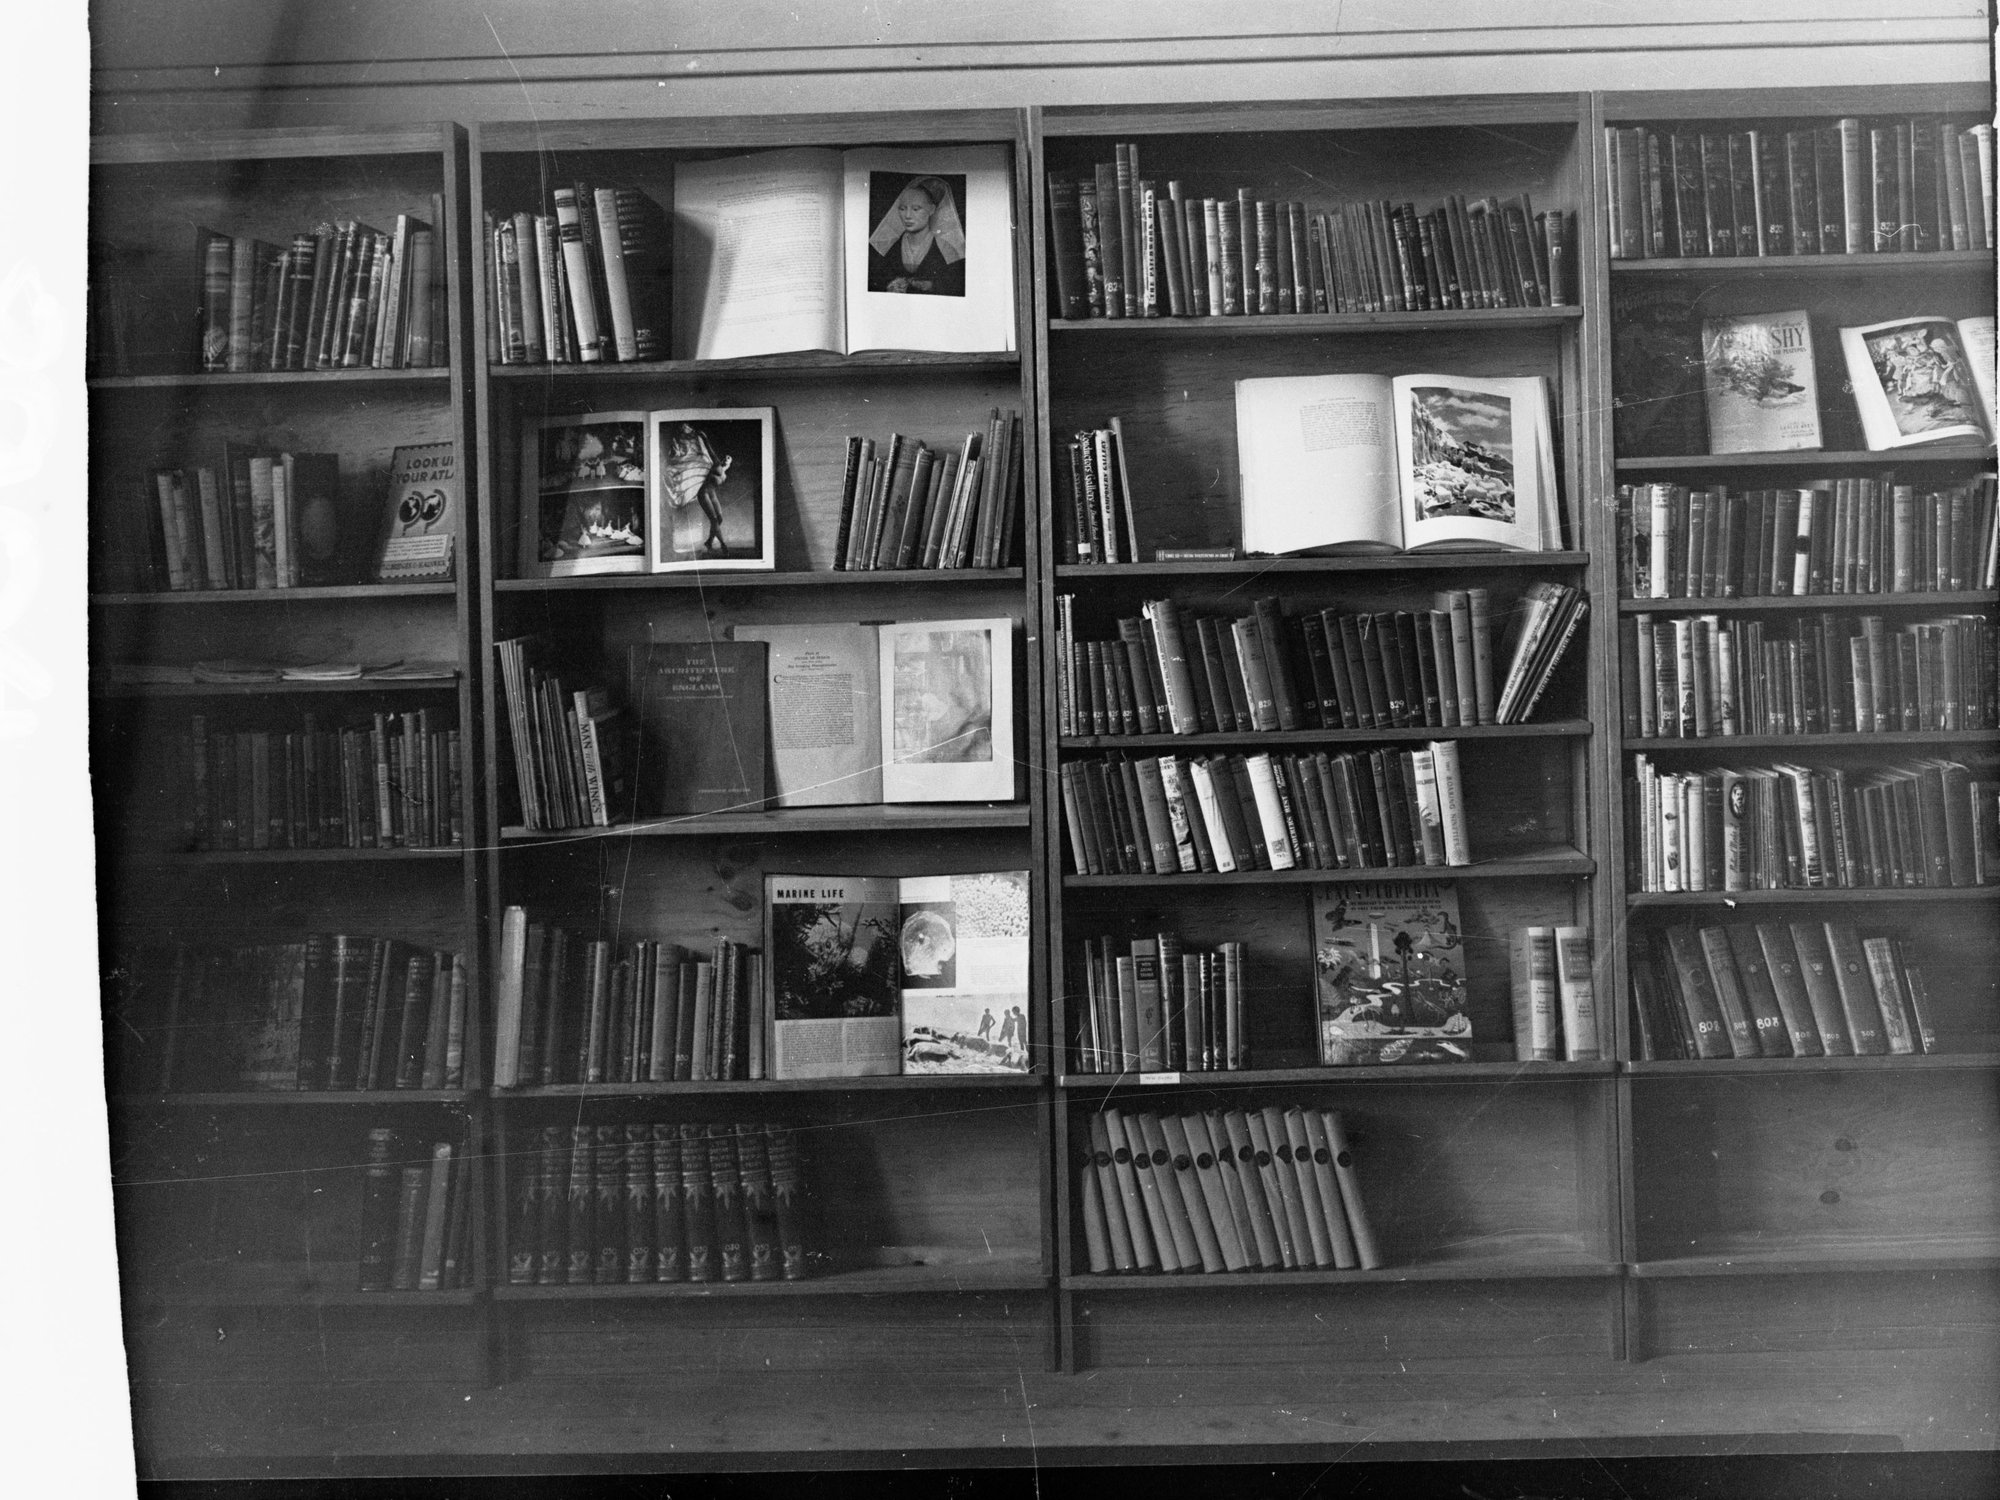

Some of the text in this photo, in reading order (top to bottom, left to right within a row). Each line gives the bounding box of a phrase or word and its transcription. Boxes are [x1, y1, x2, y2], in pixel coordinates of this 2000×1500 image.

[1771, 327, 1805, 348] SHY
[407, 457, 439, 470] LOOK
[1101, 439, 1109, 470] GALLERY
[396, 471, 428, 484] YOUR
[1389, 699, 1405, 709] 829
[579, 723, 593, 749] MAN
[588, 775, 602, 813] WINGS
[1446, 777, 1456, 810] ROARING
[1281, 794, 1290, 812] REST
[1450, 811, 1459, 848] NINETIES
[777, 889, 845, 899] MARINE LIFE
[1756, 1015, 1779, 1029] 808
